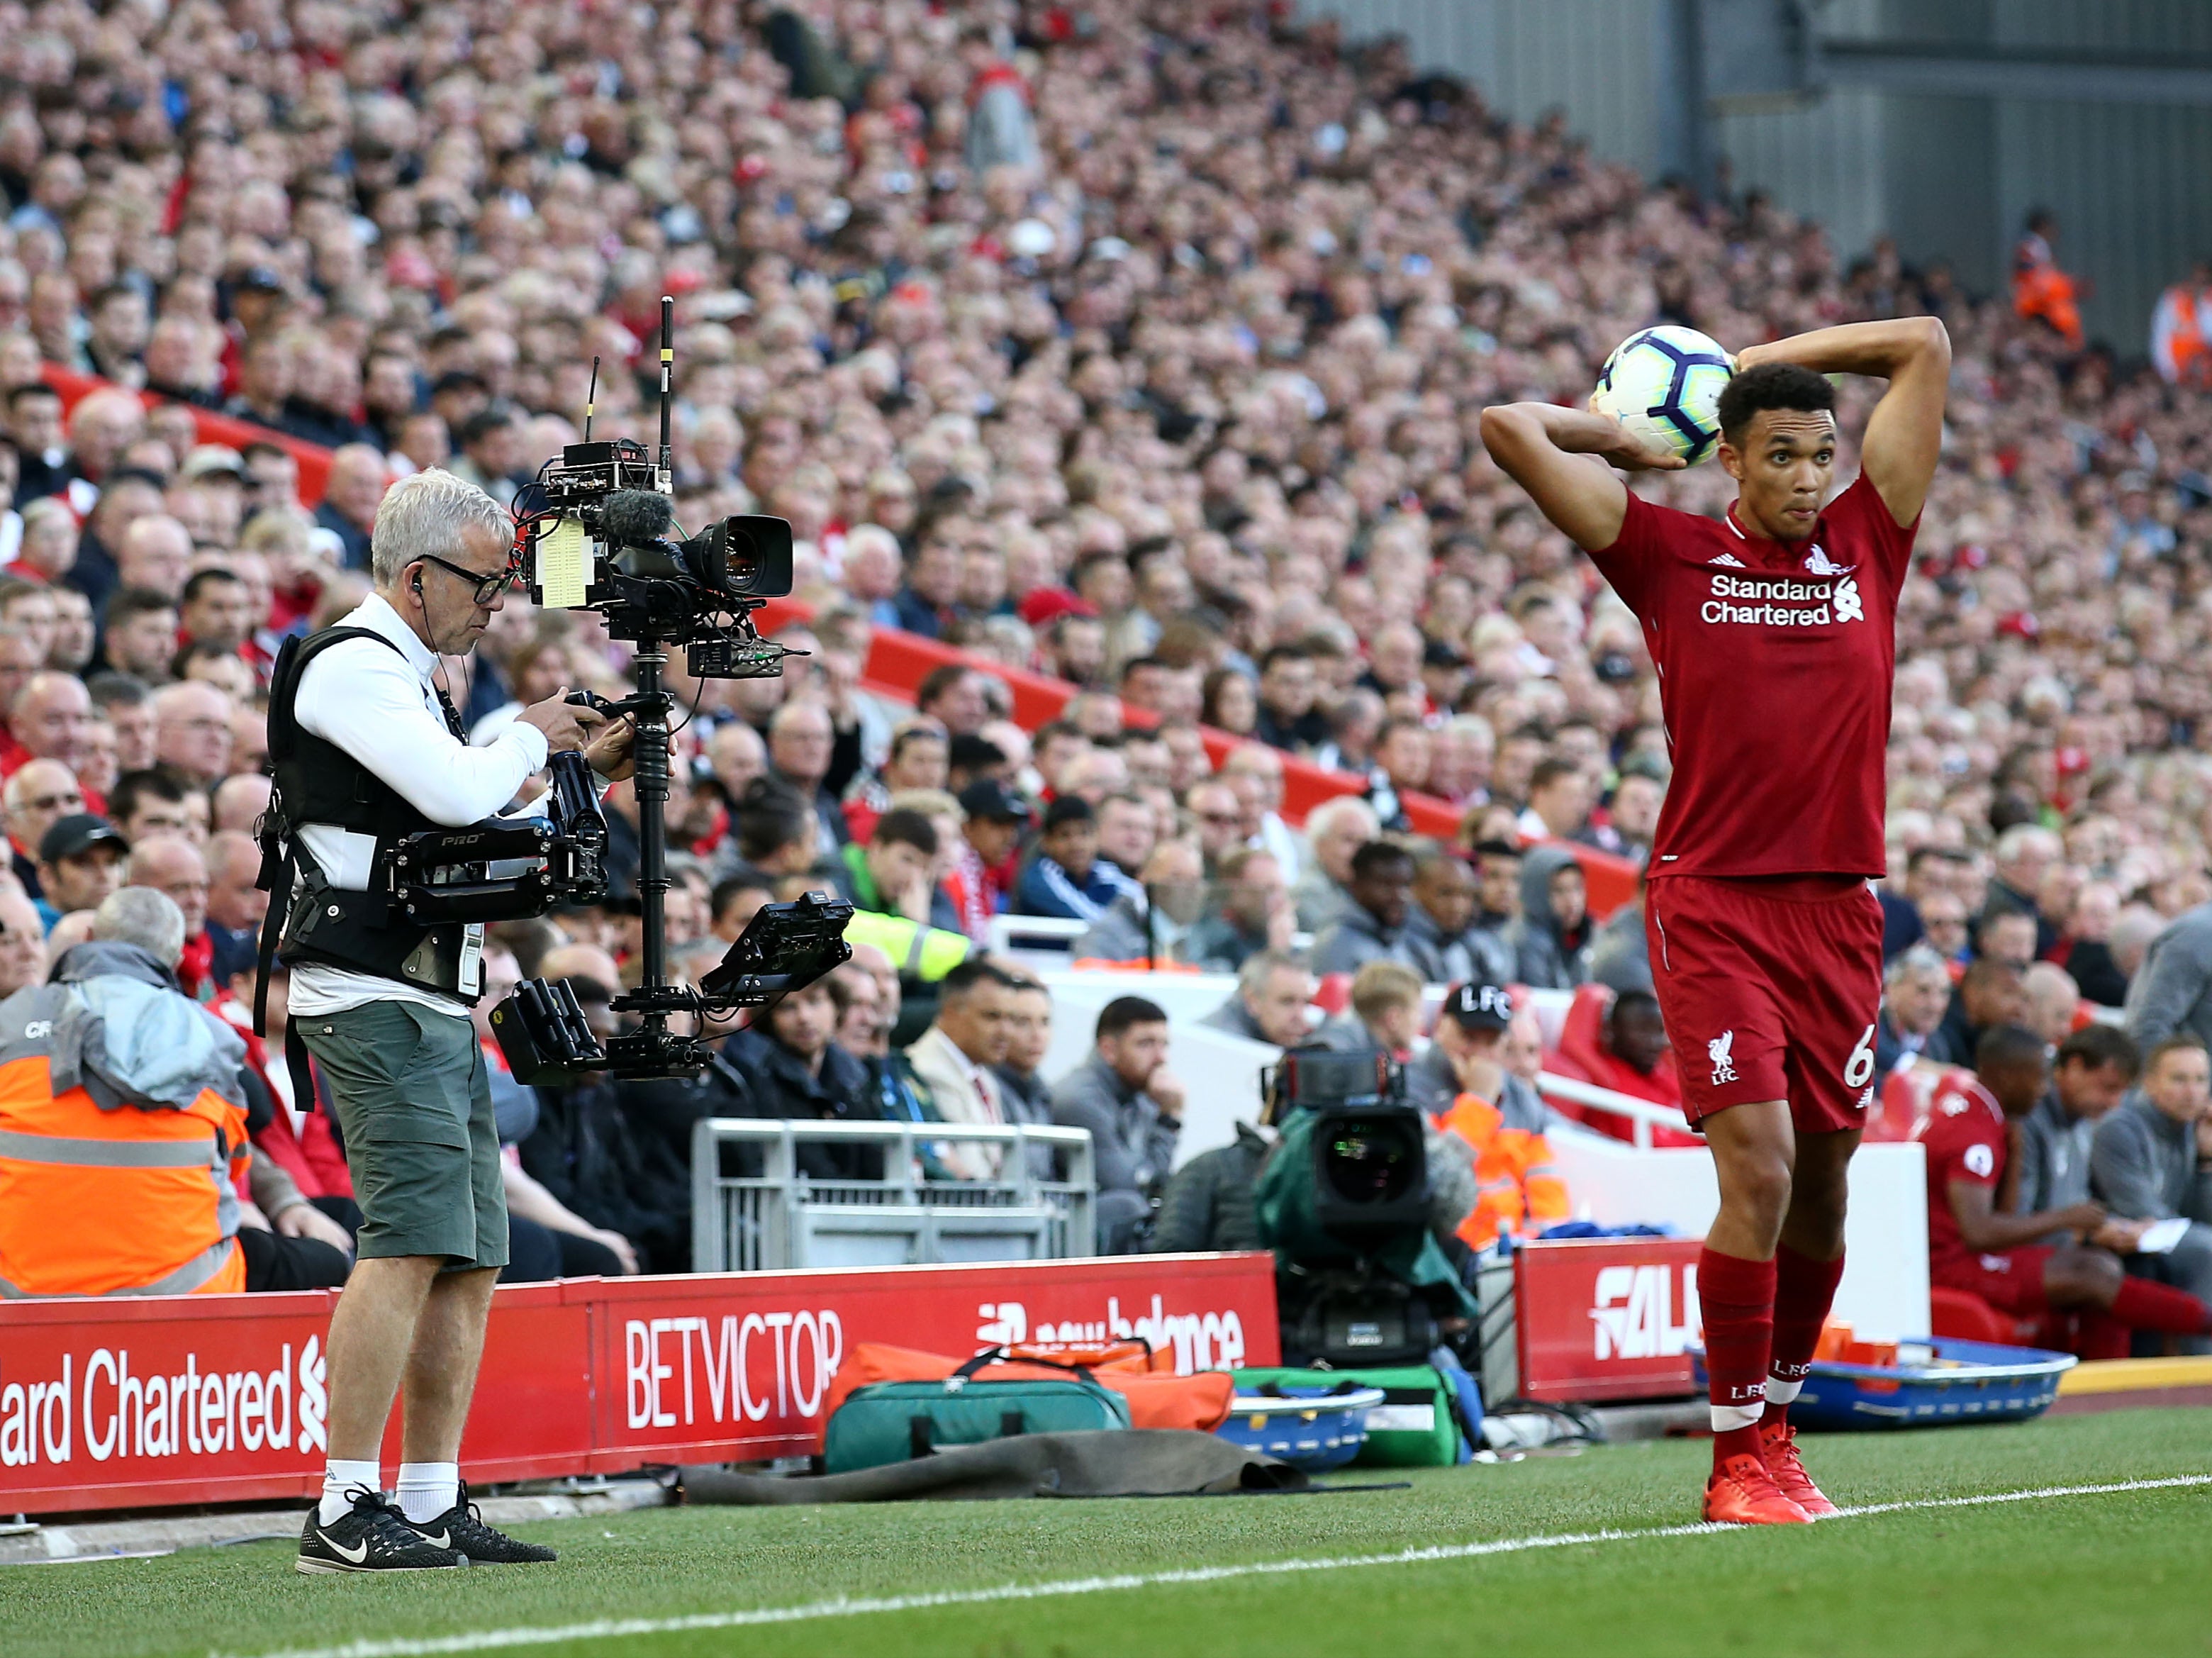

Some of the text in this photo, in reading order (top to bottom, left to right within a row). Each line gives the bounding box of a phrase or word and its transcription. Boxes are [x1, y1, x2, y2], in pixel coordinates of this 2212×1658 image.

[1710, 574, 1832, 601] Standard
[1702, 601, 1831, 626] Chartered
[442, 835, 479, 846] PRO
[1461, 985, 1513, 1020] LFC
[1844, 1023, 1875, 1088] 6
[625, 1309, 843, 1429] BETVICTOR
[83, 1342, 291, 1462] Chartered
